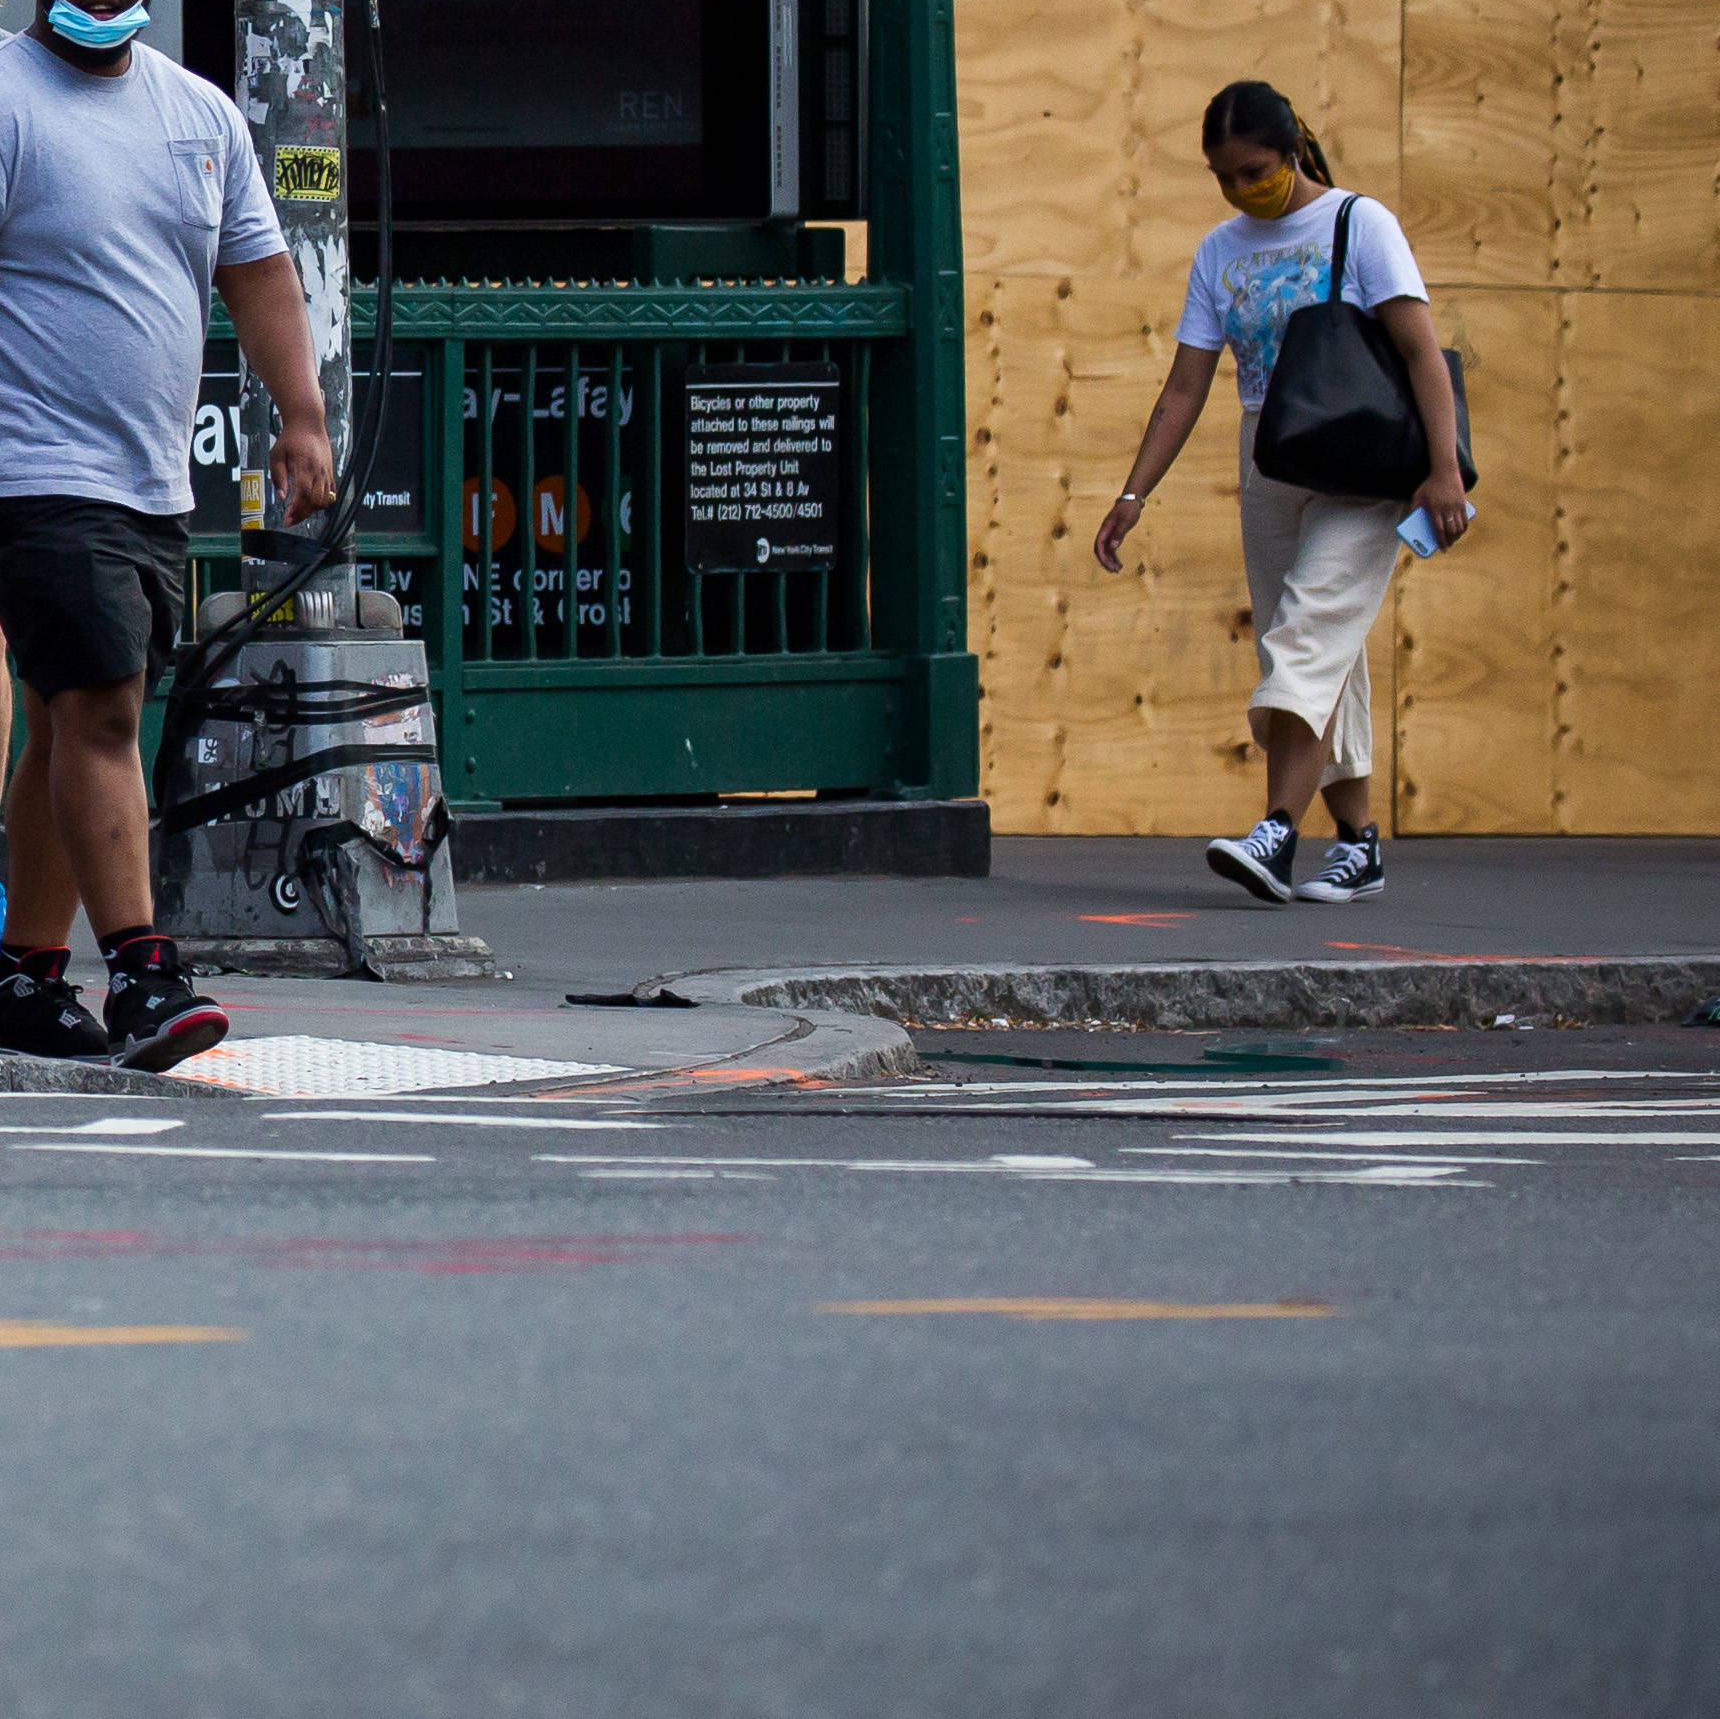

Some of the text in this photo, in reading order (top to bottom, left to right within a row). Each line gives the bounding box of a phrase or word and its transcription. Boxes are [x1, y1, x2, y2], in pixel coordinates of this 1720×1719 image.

[619, 91, 683, 120] REN
[690, 394, 820, 413] Bicycles or other property
[691, 414, 835, 434] attached to these railings will
[690, 437, 832, 455] be removed and delivered to
[691, 459, 800, 478] the Lost Property Unit
[377, 490, 411, 506] Transit
[690, 481, 810, 499] located at 34 St & 8 Av
[472, 492, 498, 536] F
[717, 504, 742, 521] (212)
[744, 502, 824, 520] 712-4500/4501
